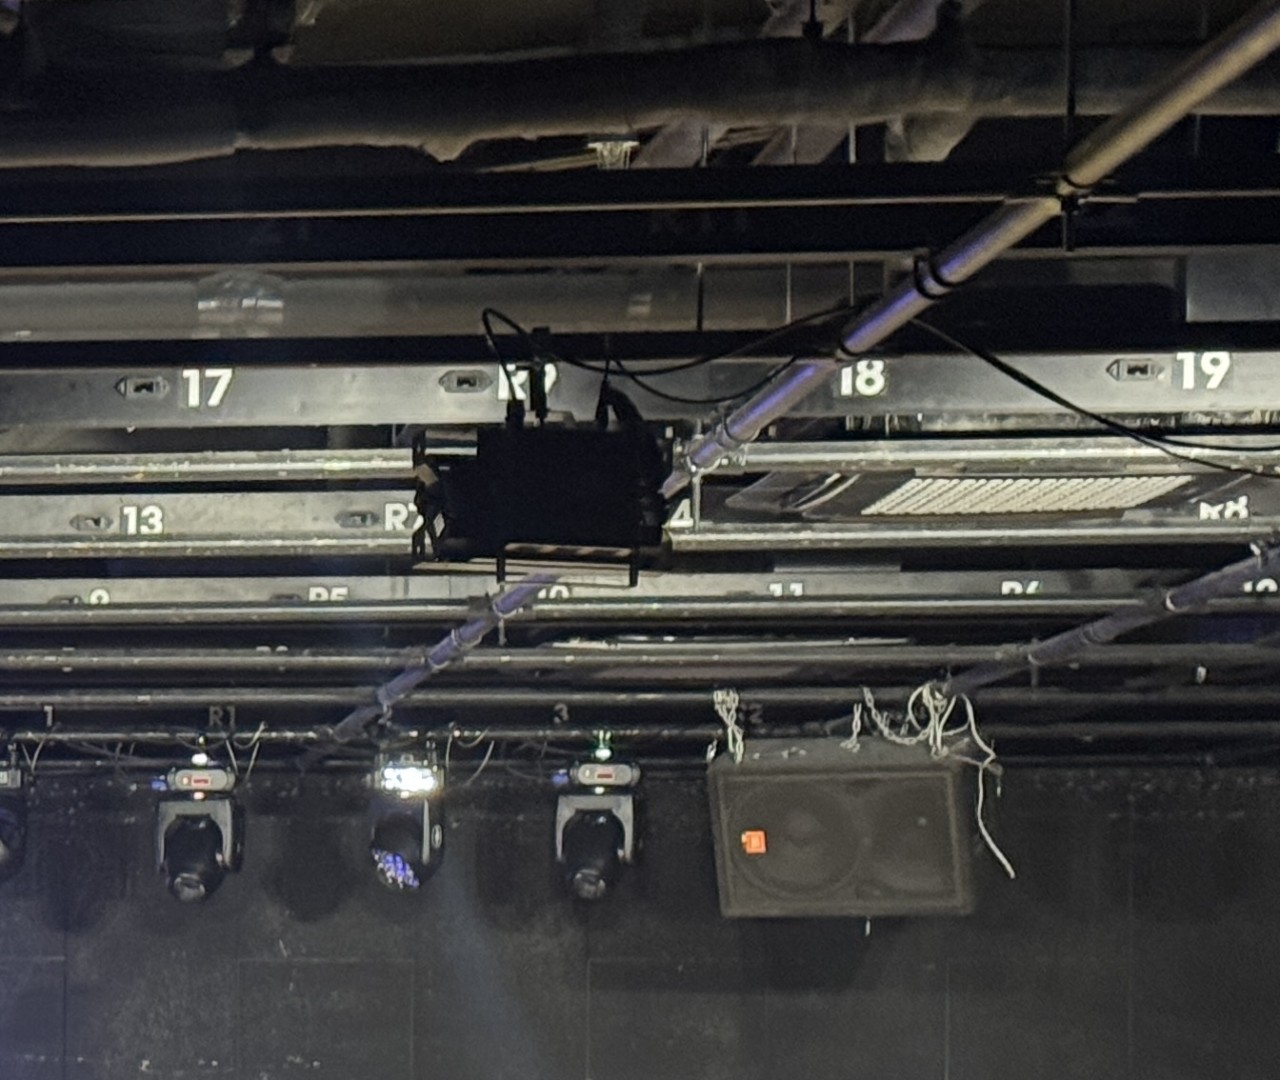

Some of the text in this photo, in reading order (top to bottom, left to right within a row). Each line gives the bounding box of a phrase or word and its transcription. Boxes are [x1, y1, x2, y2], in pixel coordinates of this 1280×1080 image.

[182, 368, 233, 408] 17
[840, 359, 885, 397] 18
[1176, 351, 1230, 390] 19
[122, 504, 163, 535] 13
